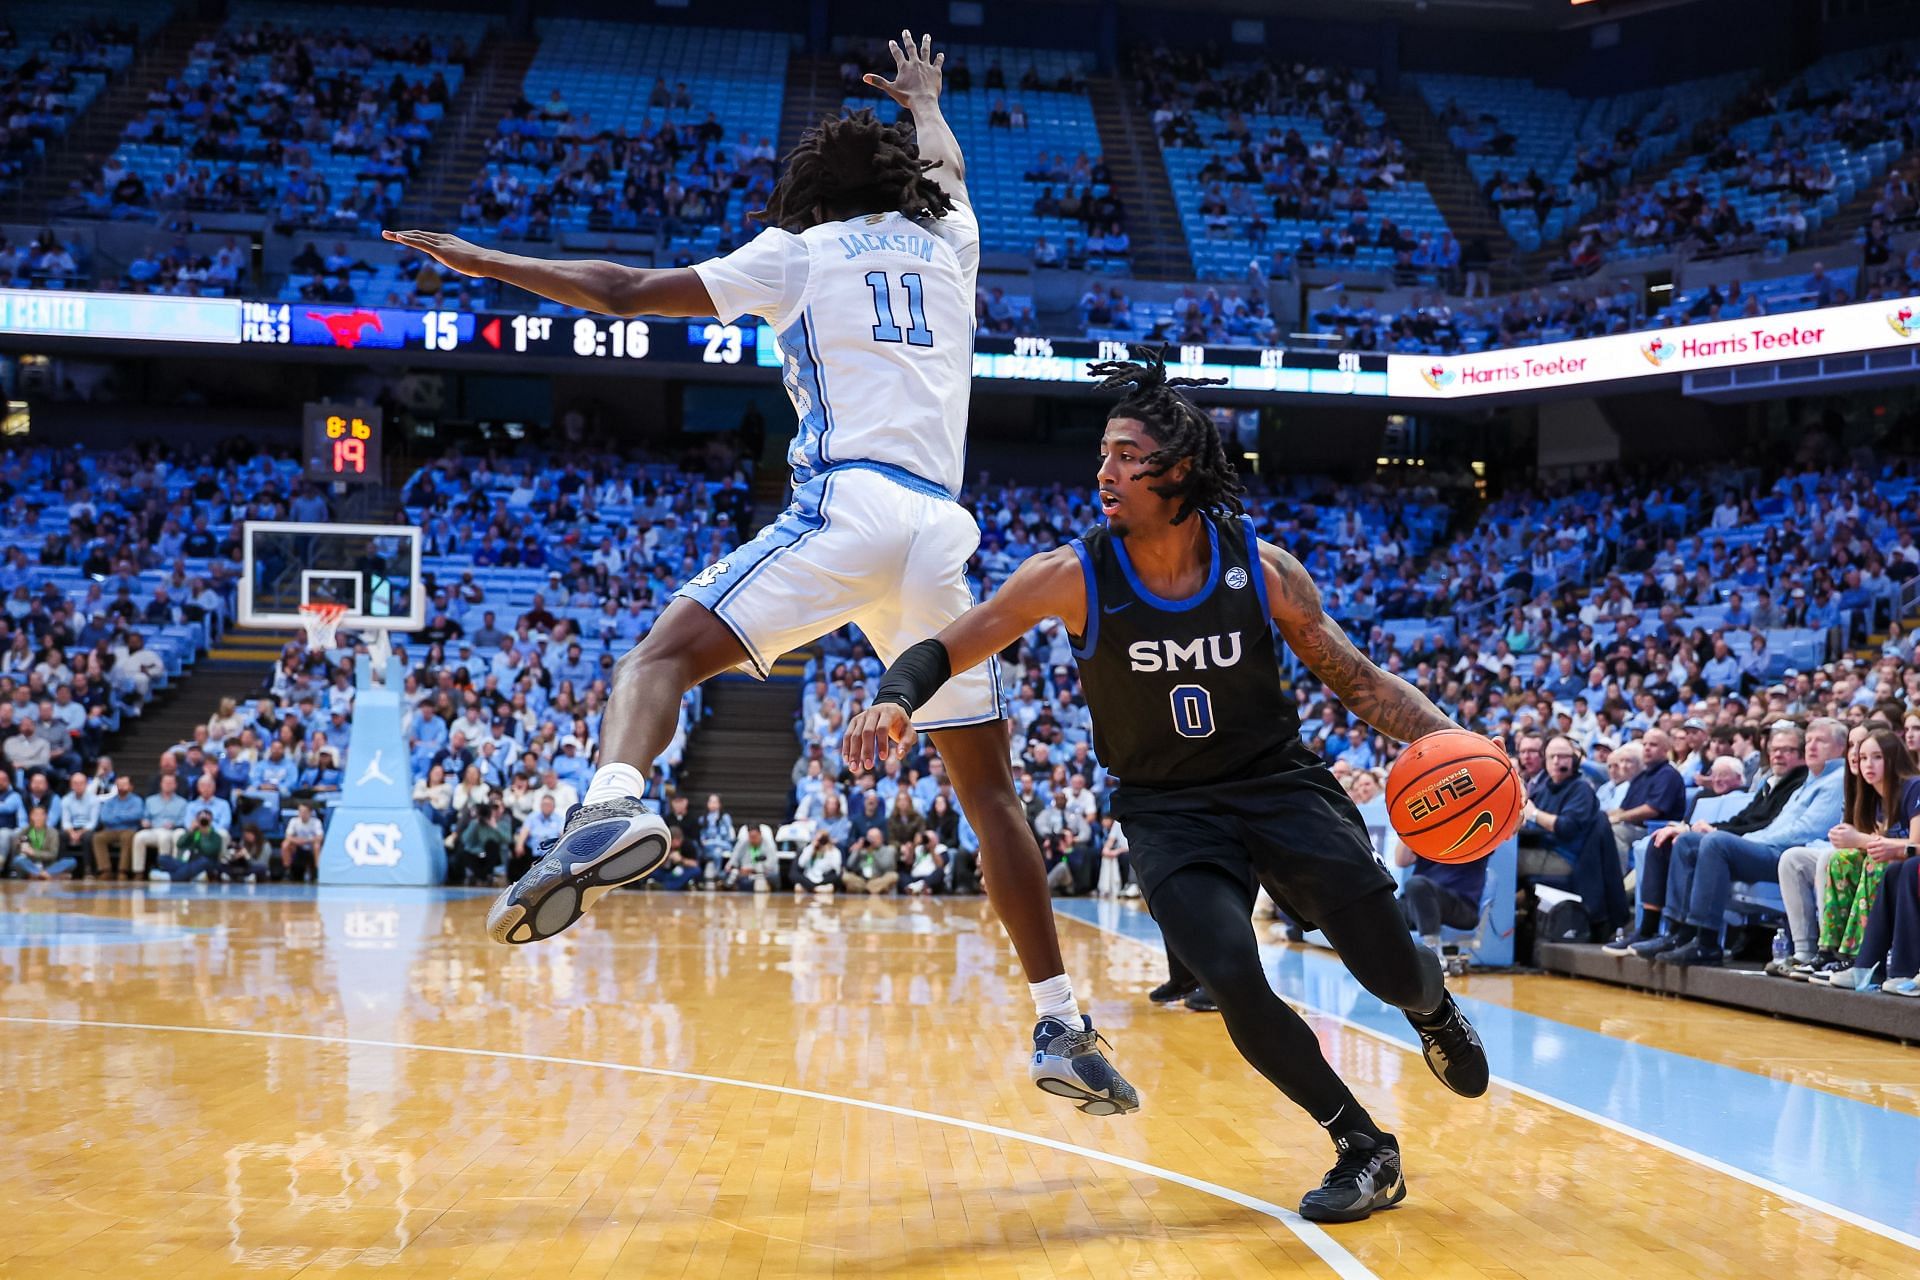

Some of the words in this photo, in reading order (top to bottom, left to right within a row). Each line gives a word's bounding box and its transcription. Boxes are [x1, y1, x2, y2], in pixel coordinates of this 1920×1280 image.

[838, 232, 935, 263] JACKSON
[13, 296, 86, 329] CENTER
[277, 303, 291, 324] 4
[864, 270, 934, 348] 11
[277, 323, 291, 345] 3
[422, 311, 459, 351] 15
[511, 315, 552, 352] 1ST
[573, 319, 650, 359] 8:16
[703, 324, 742, 364] 23
[1682, 334, 1748, 359] Harris
[1751, 326, 1826, 349] Teeter
[1260, 349, 1284, 369] AST
[1462, 362, 1520, 386] Harris
[1523, 355, 1588, 378] Teeter
[326, 415, 372, 440] 8:16
[334, 437, 365, 473] 19
[1128, 631, 1242, 673] SMU
[1169, 684, 1217, 739] 0
[1405, 767, 1469, 804] CHAMPIONSHIP
[1407, 773, 1478, 823] ELITE
